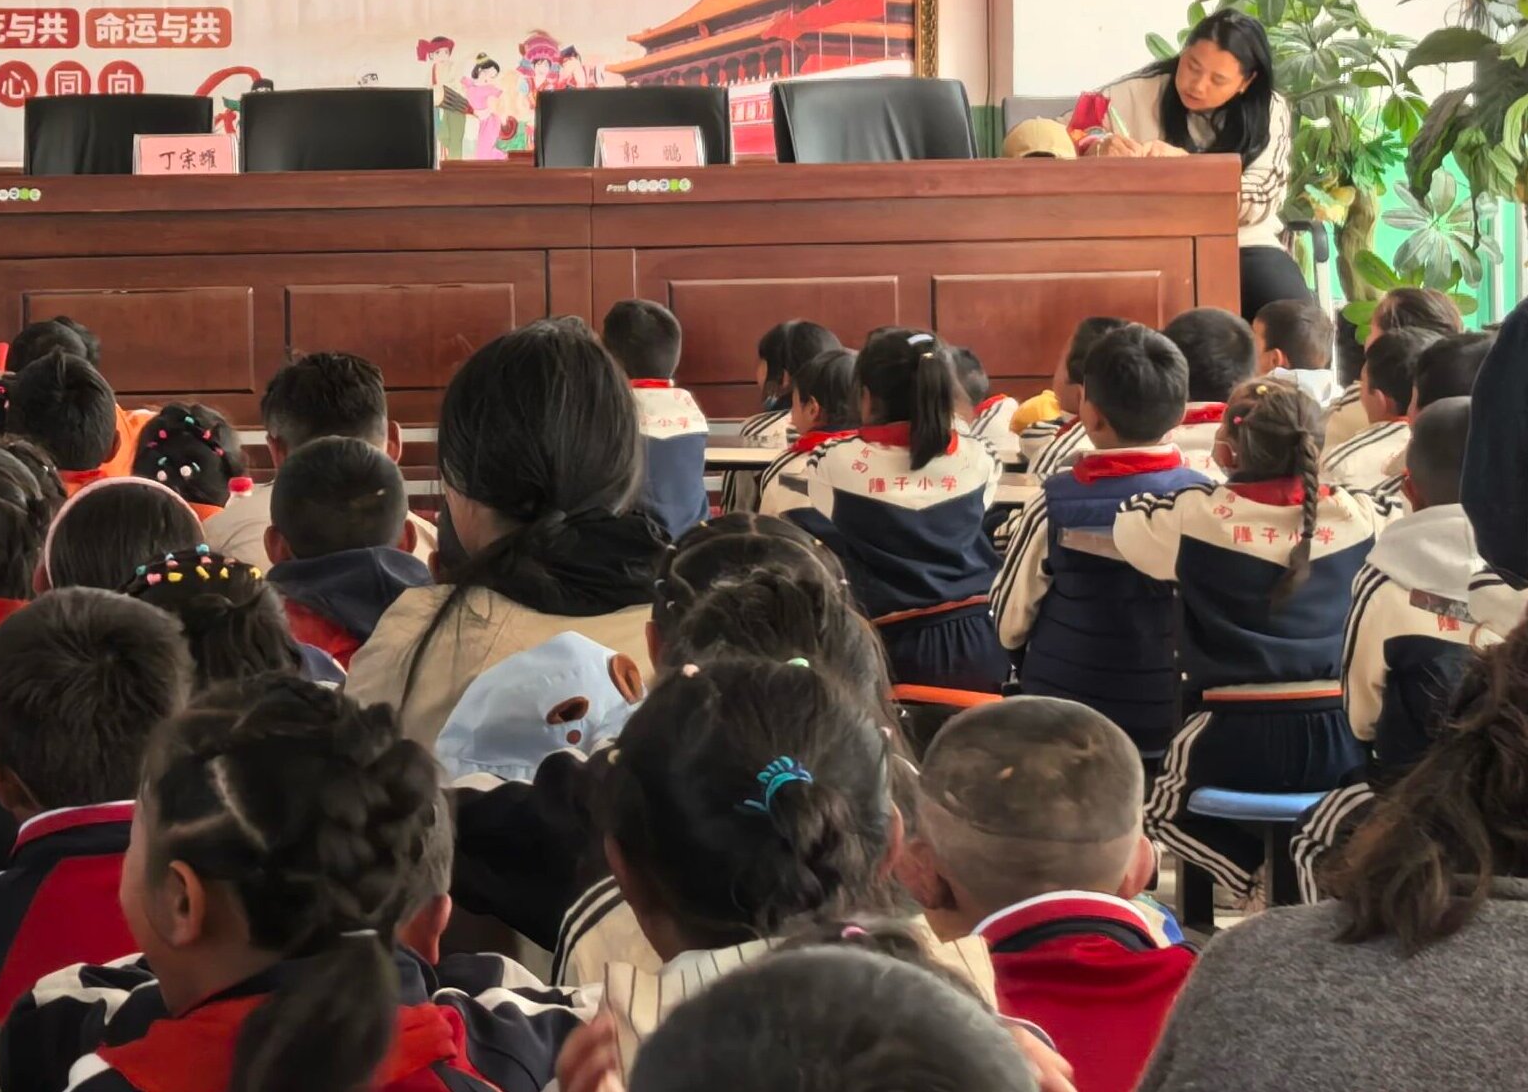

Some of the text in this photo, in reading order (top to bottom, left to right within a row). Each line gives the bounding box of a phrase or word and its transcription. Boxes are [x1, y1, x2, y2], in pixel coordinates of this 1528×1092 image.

[94, 12, 222, 45] 命运与共
[868, 475, 958, 495] 隆子小学
